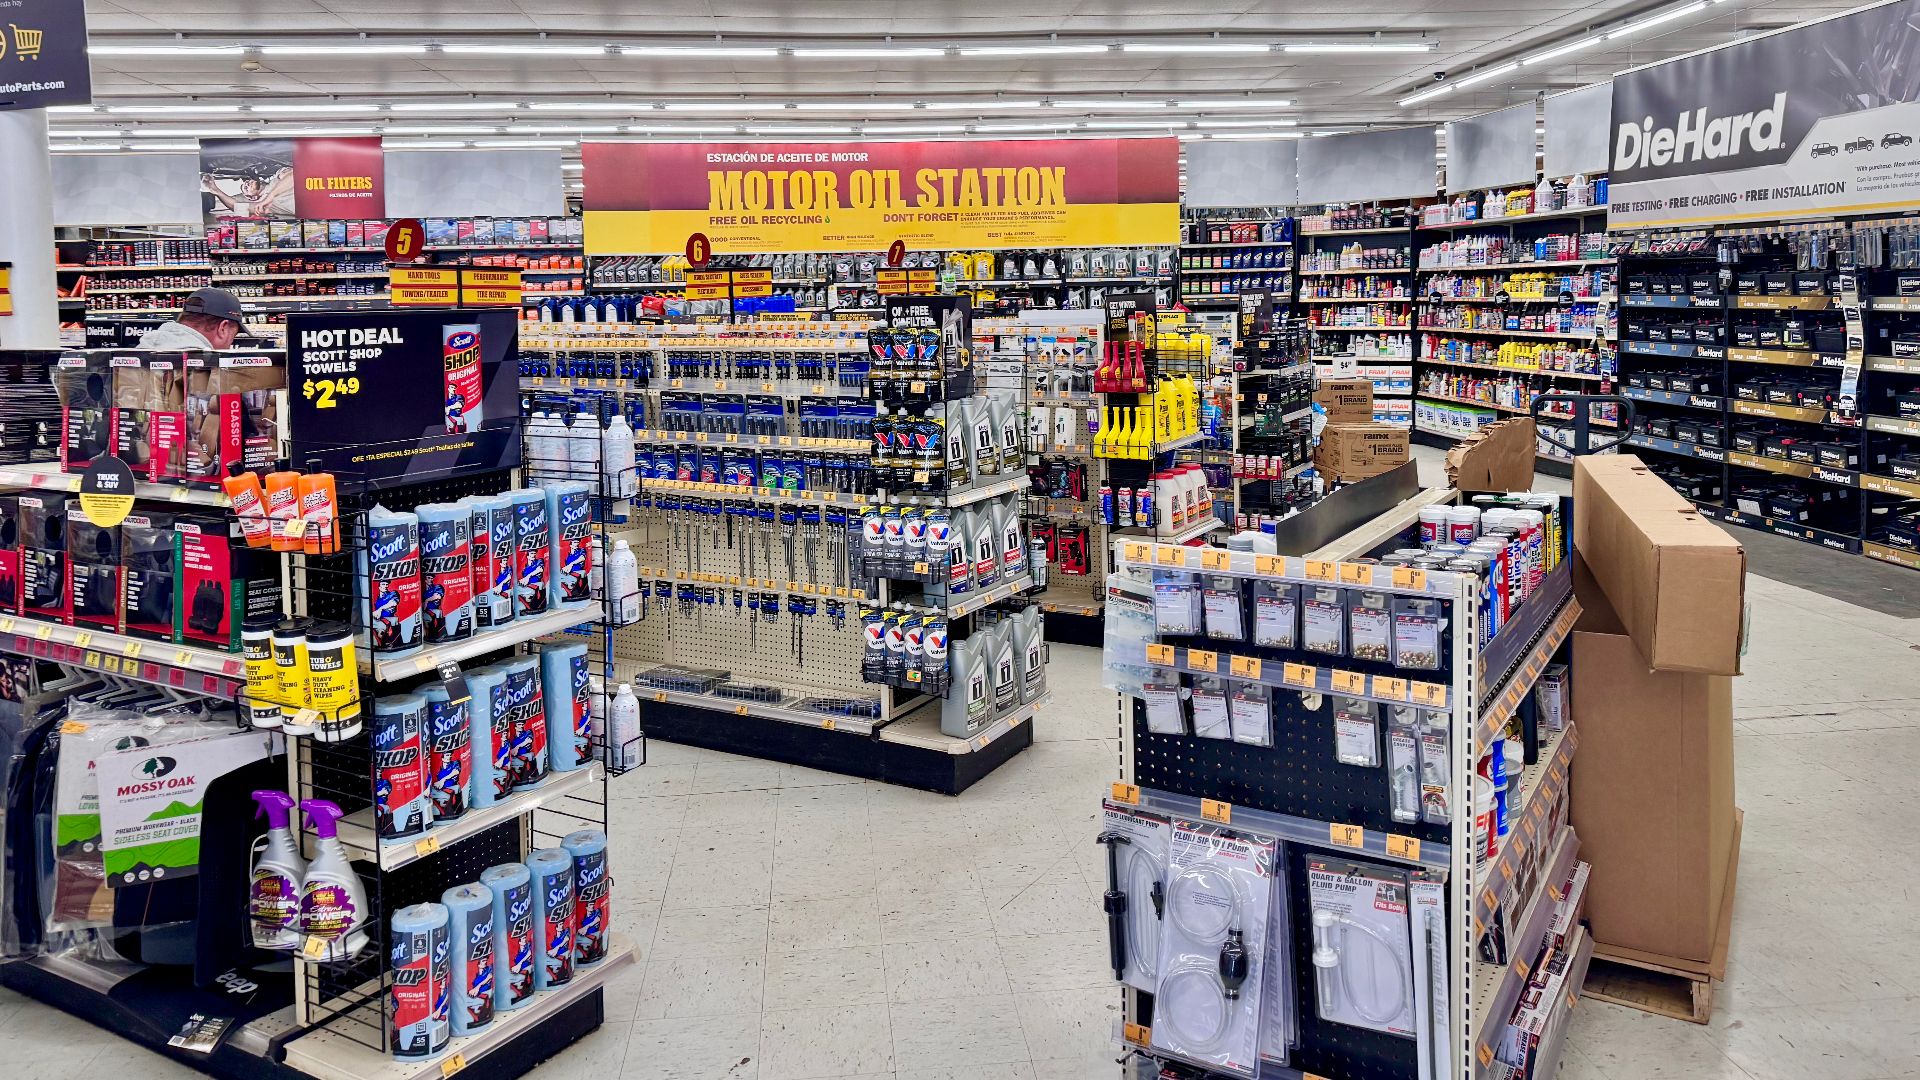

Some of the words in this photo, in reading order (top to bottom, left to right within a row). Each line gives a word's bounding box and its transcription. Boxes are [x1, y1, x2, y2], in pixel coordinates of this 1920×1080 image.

[1613, 92, 1787, 171] DieHard
[707, 151, 757, 163] ESTACIÓN
[760, 153, 774, 162] DE
[776, 153, 812, 162] ACEITE
[815, 153, 829, 162] DE
[831, 152, 868, 162] MOTOR
[305, 177, 326, 190] OIL
[327, 176, 373, 190] FILTERS
[708, 170, 840, 211] MOTOR
[850, 168, 907, 209] OIL
[915, 166, 1066, 208] STATION
[1611, 203, 1630, 214] FREE
[1632, 200, 1662, 212] TESTING
[1669, 197, 1689, 209] FREE
[1691, 192, 1738, 206] CHARGING
[1745, 188, 1769, 202] FREE
[709, 216, 737, 225] FREE
[740, 216, 758, 225] OIL
[761, 215, 822, 224] RECYCLING
[883, 213, 915, 223] DON'T
[917, 212, 959, 222] FORGET
[396, 227, 412, 255] 5
[693, 239, 703, 262] 6
[424, 271, 441, 279] TOOLS
[474, 273, 509, 281] PERFORMANCE
[1695, 298, 1720, 307] DieHard
[910, 305, 929, 316] FREE
[87, 326, 115, 337] DieHard
[1760, 331, 1777, 339] DieHard
[301, 329, 347, 349] HOT
[350, 327, 403, 346] DEAL
[453, 335, 472, 347] Scott
[350, 348, 383, 360] SHOP
[1698, 348, 1723, 358] DieHard
[1895, 344, 1918, 352] DieHard
[445, 344, 480, 371] SHOP
[303, 361, 357, 375] TOWELS
[448, 363, 478, 382] ORIGINAL
[1692, 399, 1717, 409] DieHard
[231, 400, 239, 446] CLASSIC
[376, 452, 403, 460] ESPECIAL
[1698, 449, 1724, 460] DieHard
[1791, 450, 1808, 458] DieHard
[1821, 450, 1840, 460] DieHard
[96, 473, 119, 481] TRUCK
[1819, 470, 1851, 485] DieHard
[1893, 466, 1917, 477] DieHard
[103, 481, 119, 489] SUV
[1867, 482, 1881, 490] GOLD
[1698, 507, 1715, 517] DieHard
[1772, 506, 1791, 517] DieHard
[420, 529, 450, 556] Scott
[1823, 538, 1845, 550] DieHard
[1889, 533, 1912, 545] DieHard
[370, 533, 405, 563] Scott
[421, 554, 467, 575] SHOP
[1507, 547, 1515, 583] Mobil
[1513, 541, 1521, 577] Mobil
[373, 557, 419, 581] SHOP
[311, 661, 341, 670] TOWELS
[313, 685, 345, 693] CLEANING
[376, 724, 396, 747] cott
[390, 771, 420, 781] ORIGINAL
[117, 779, 165, 797] MOSSY
[168, 775, 195, 789] OAK
[1104, 810, 1119, 820] FLUID
[1119, 813, 1145, 827] LUBRICANT
[1145, 819, 1160, 829] PUMP
[115, 825, 141, 835] PREMIUM
[180, 817, 197, 825] BLACK
[113, 833, 151, 845] SIDELESS
[152, 829, 172, 839] SEAT
[173, 824, 199, 836] COVER
[1174, 831, 1195, 842] FLUID
[1226, 840, 1250, 853] PUMP
[1311, 872, 1334, 882] QUART
[1344, 876, 1373, 888] GALLON
[1311, 880, 1333, 890] FLUID
[1335, 883, 1357, 893] PUMP
[251, 900, 297, 909] POWER
[310, 905, 342, 913] Extreme
[1375, 901, 1386, 909] Fits
[301, 910, 355, 921] POWER
[398, 991, 427, 999] ORIGINAL
